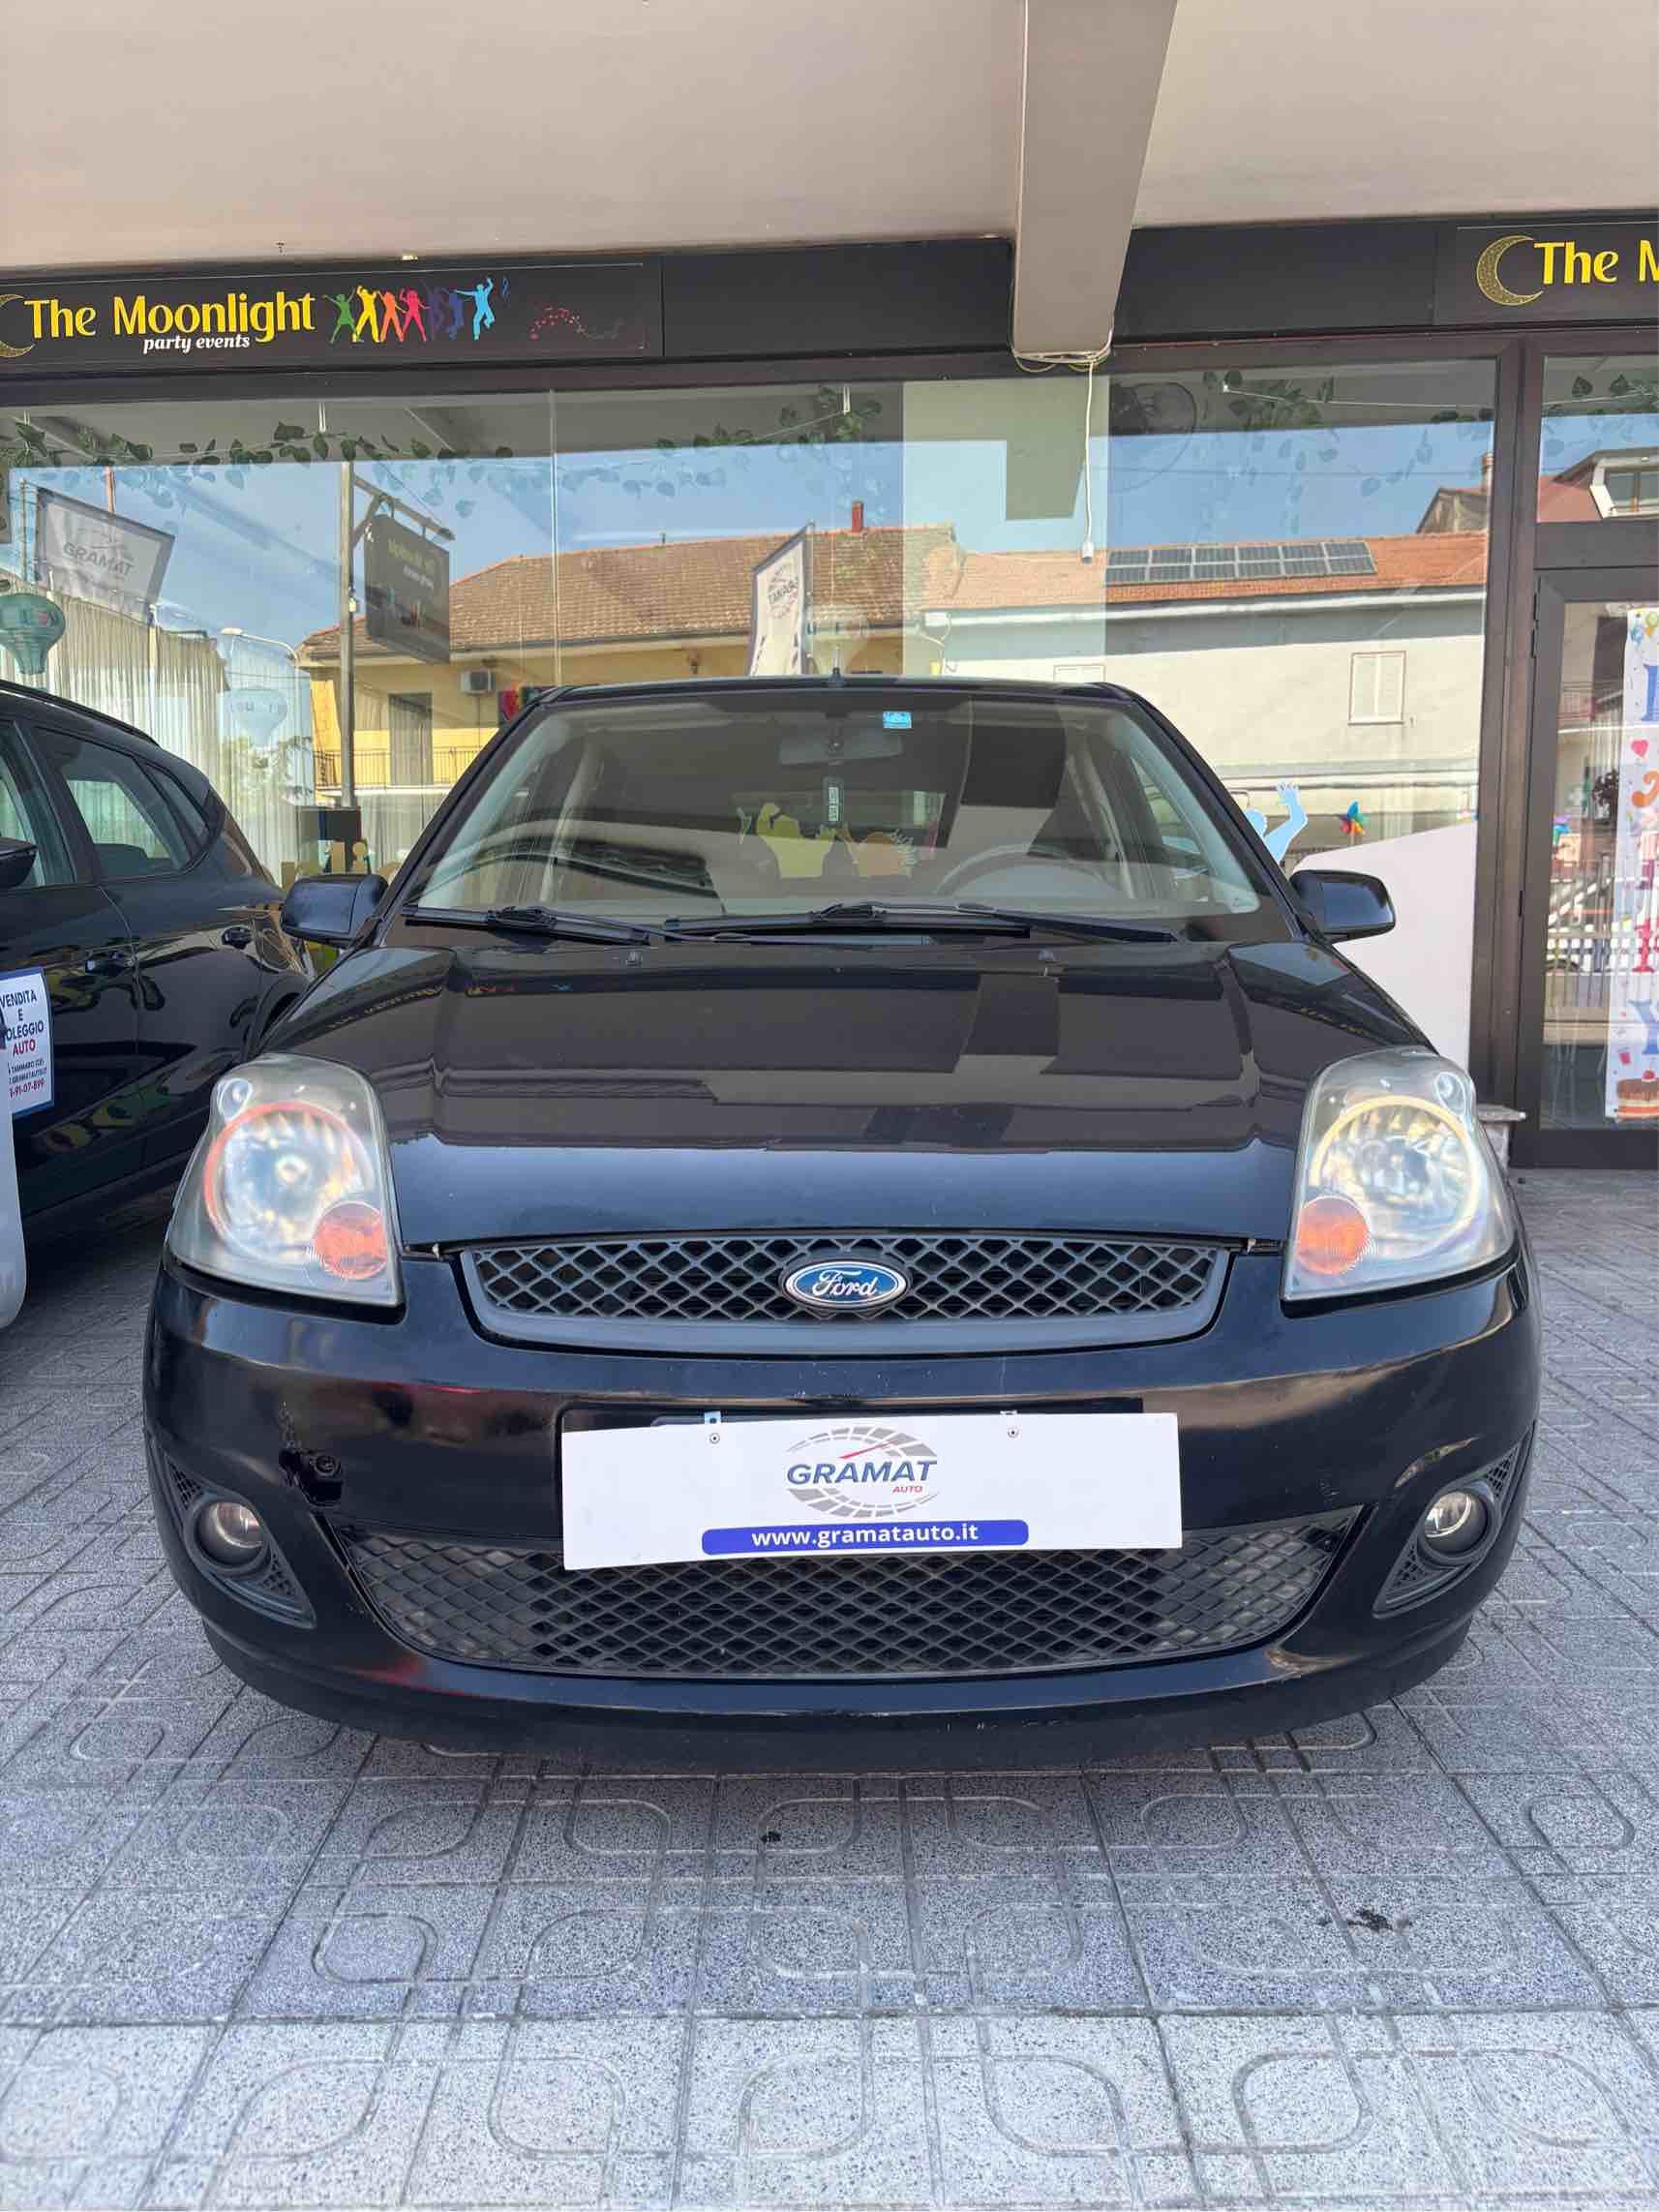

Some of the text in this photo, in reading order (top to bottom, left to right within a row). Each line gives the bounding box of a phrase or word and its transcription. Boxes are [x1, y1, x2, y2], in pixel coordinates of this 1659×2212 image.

[1533, 240, 1619, 285] The
[24, 291, 317, 343] The Moonlight
[143, 333, 251, 354] party events
[0, 989, 38, 1008] VENDITA
[17, 1008, 24, 1021] E
[6, 1020, 45, 1042] OLEGGIO
[13, 1039, 36, 1056] AUTO
[811, 1269, 881, 1296] Ford
[786, 1460, 938, 1485] GRAMAT
[751, 1524, 980, 1548] www.gramatauto.it
